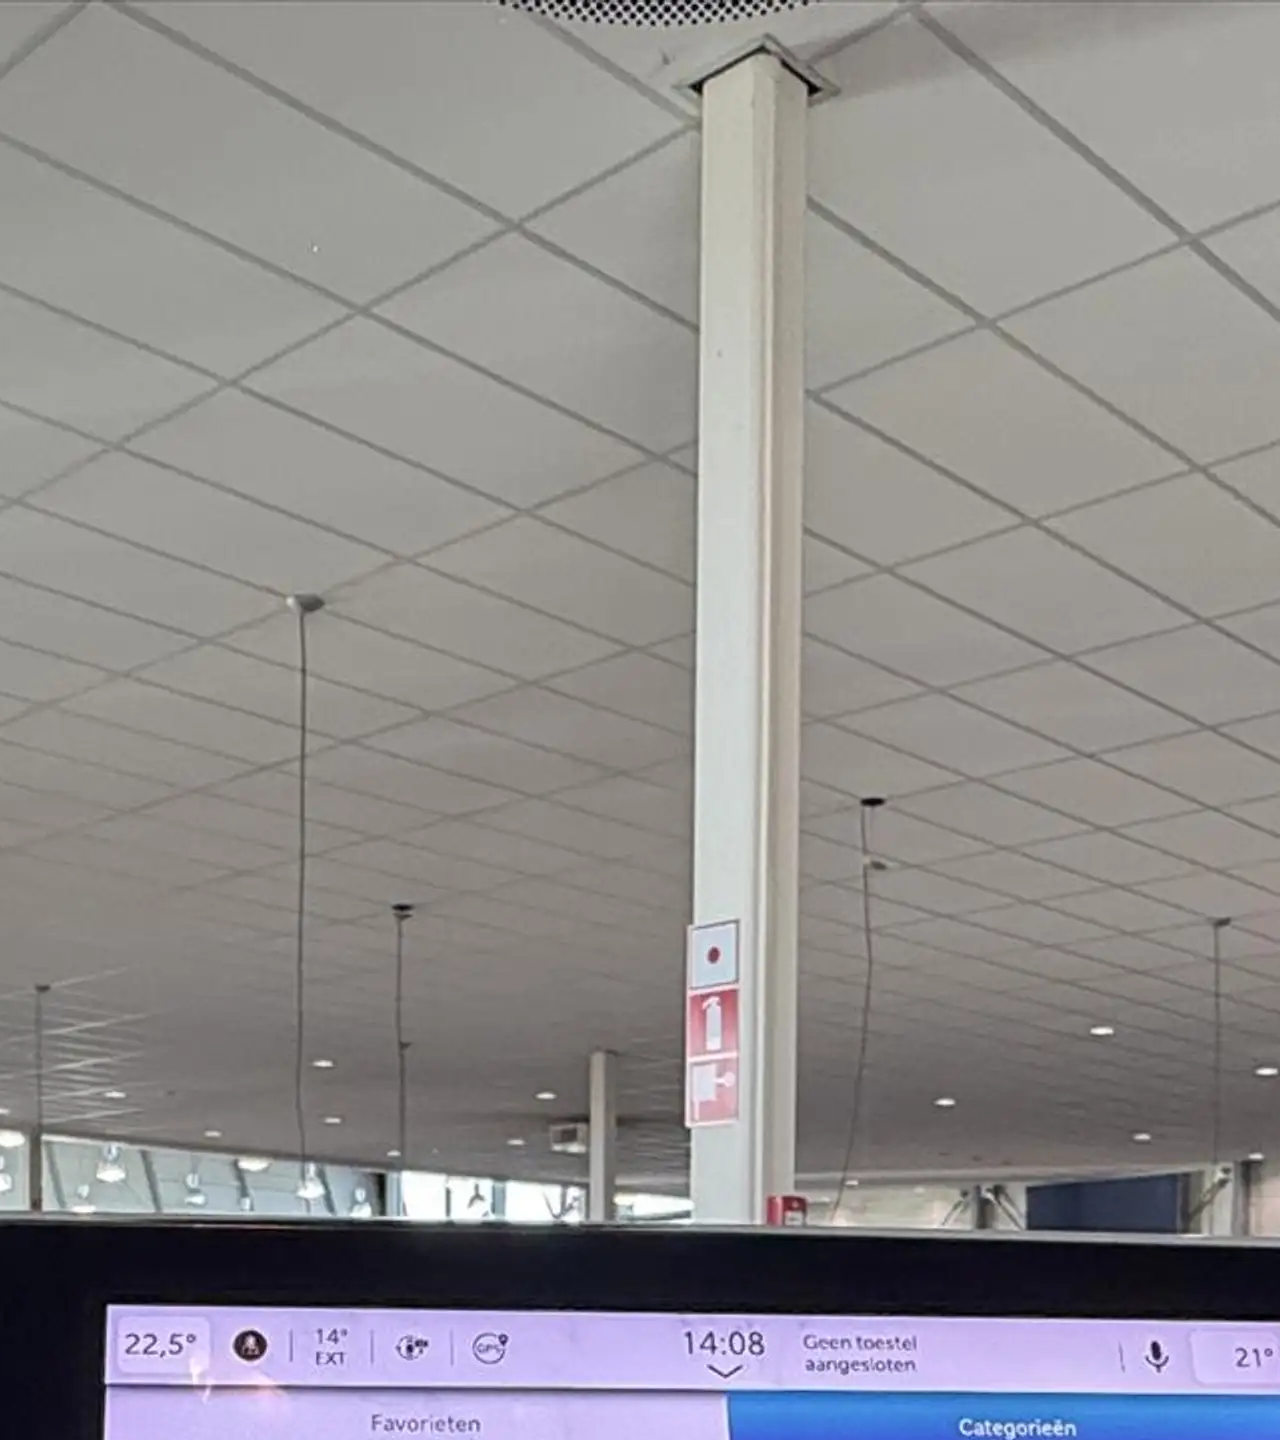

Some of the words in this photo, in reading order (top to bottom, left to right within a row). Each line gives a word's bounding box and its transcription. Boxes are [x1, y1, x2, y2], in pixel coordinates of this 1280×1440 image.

[124, 1332, 198, 1357] 22,5°
[316, 1328, 348, 1345] 14°
[684, 1331, 765, 1356] 14:08
[803, 1334, 852, 1350] Geen
[855, 1334, 917, 1351] toestel
[315, 1351, 347, 1366] EXT
[804, 1357, 918, 1375] aangesloten
[1234, 1346, 1274, 1369] 21°
[370, 1413, 482, 1433] Favorieten
[958, 1416, 1078, 1440] Categorieën
